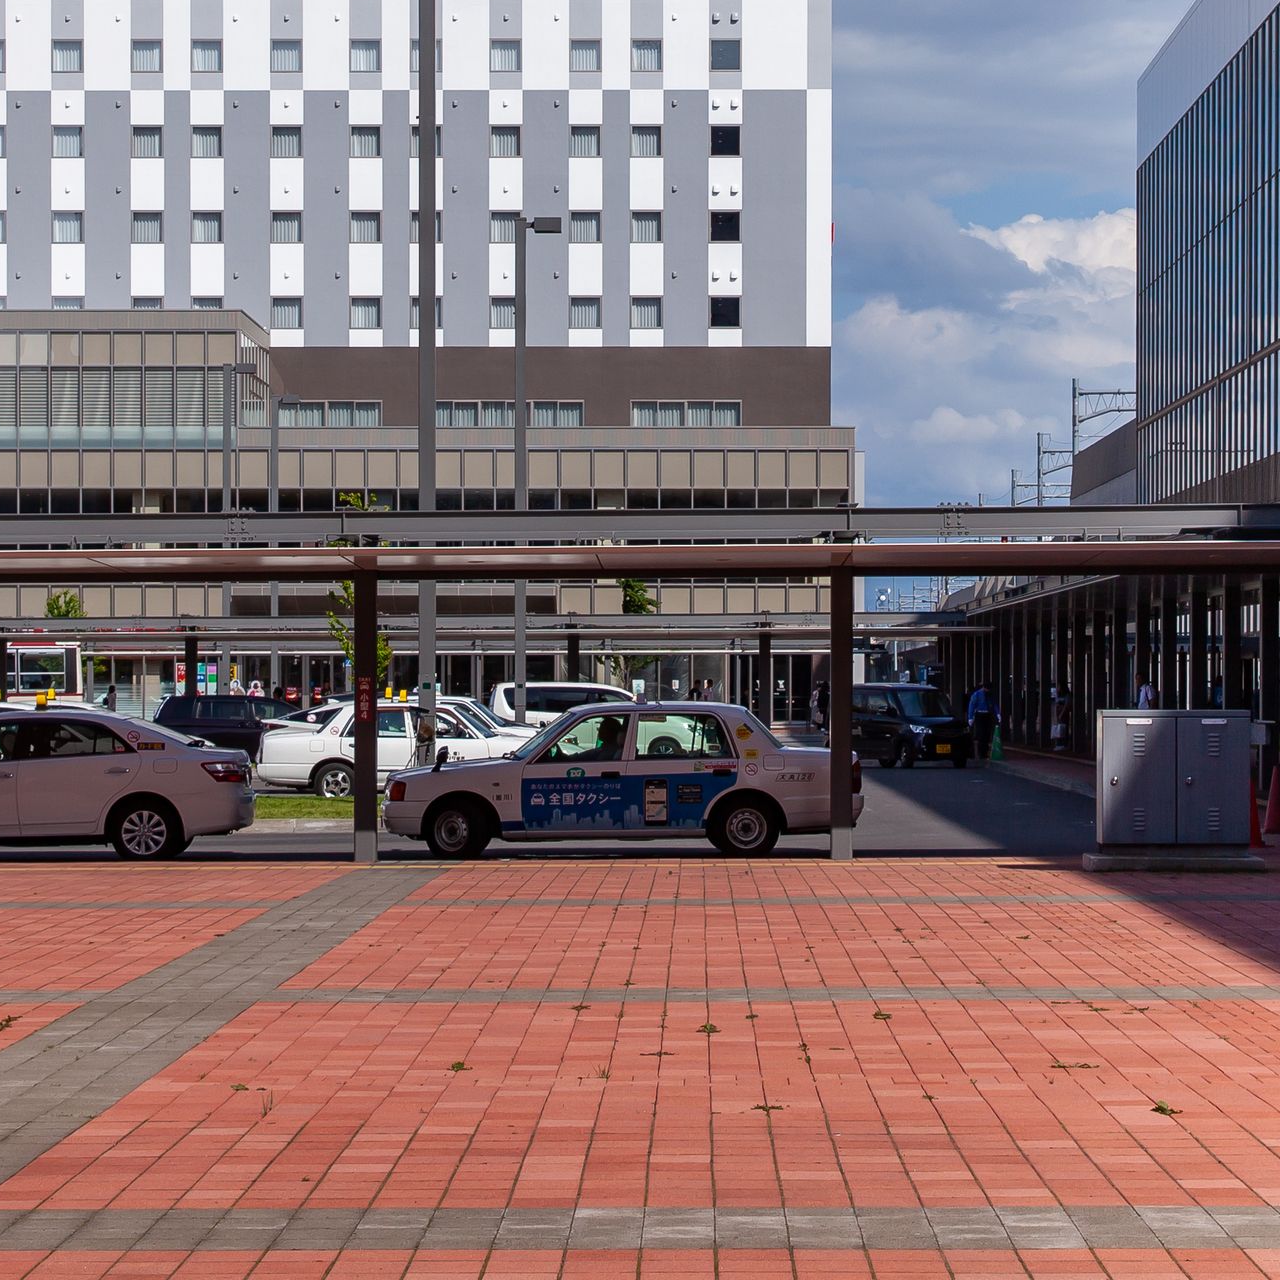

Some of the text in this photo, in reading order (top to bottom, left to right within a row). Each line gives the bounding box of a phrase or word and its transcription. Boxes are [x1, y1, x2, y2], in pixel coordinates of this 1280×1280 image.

[548, 793, 622, 805] 全国タクシー
